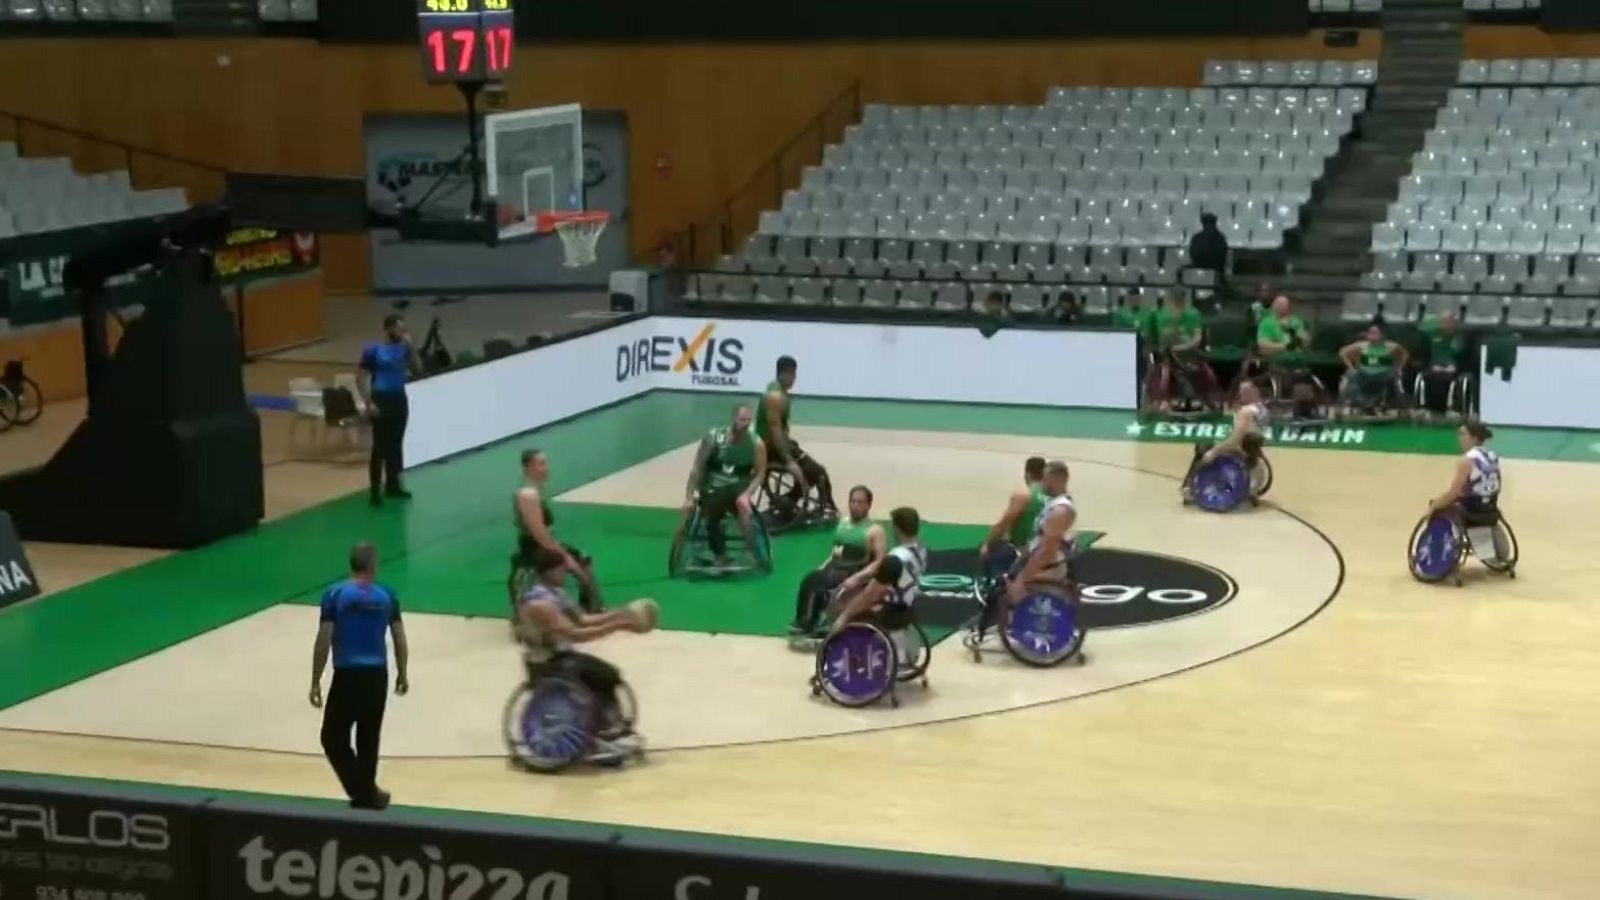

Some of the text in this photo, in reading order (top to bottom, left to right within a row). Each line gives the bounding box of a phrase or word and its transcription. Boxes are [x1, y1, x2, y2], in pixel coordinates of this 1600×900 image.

[426, 28, 476, 74] 17
[484, 26, 513, 71] 17
[616, 321, 744, 383] DIREXIS
